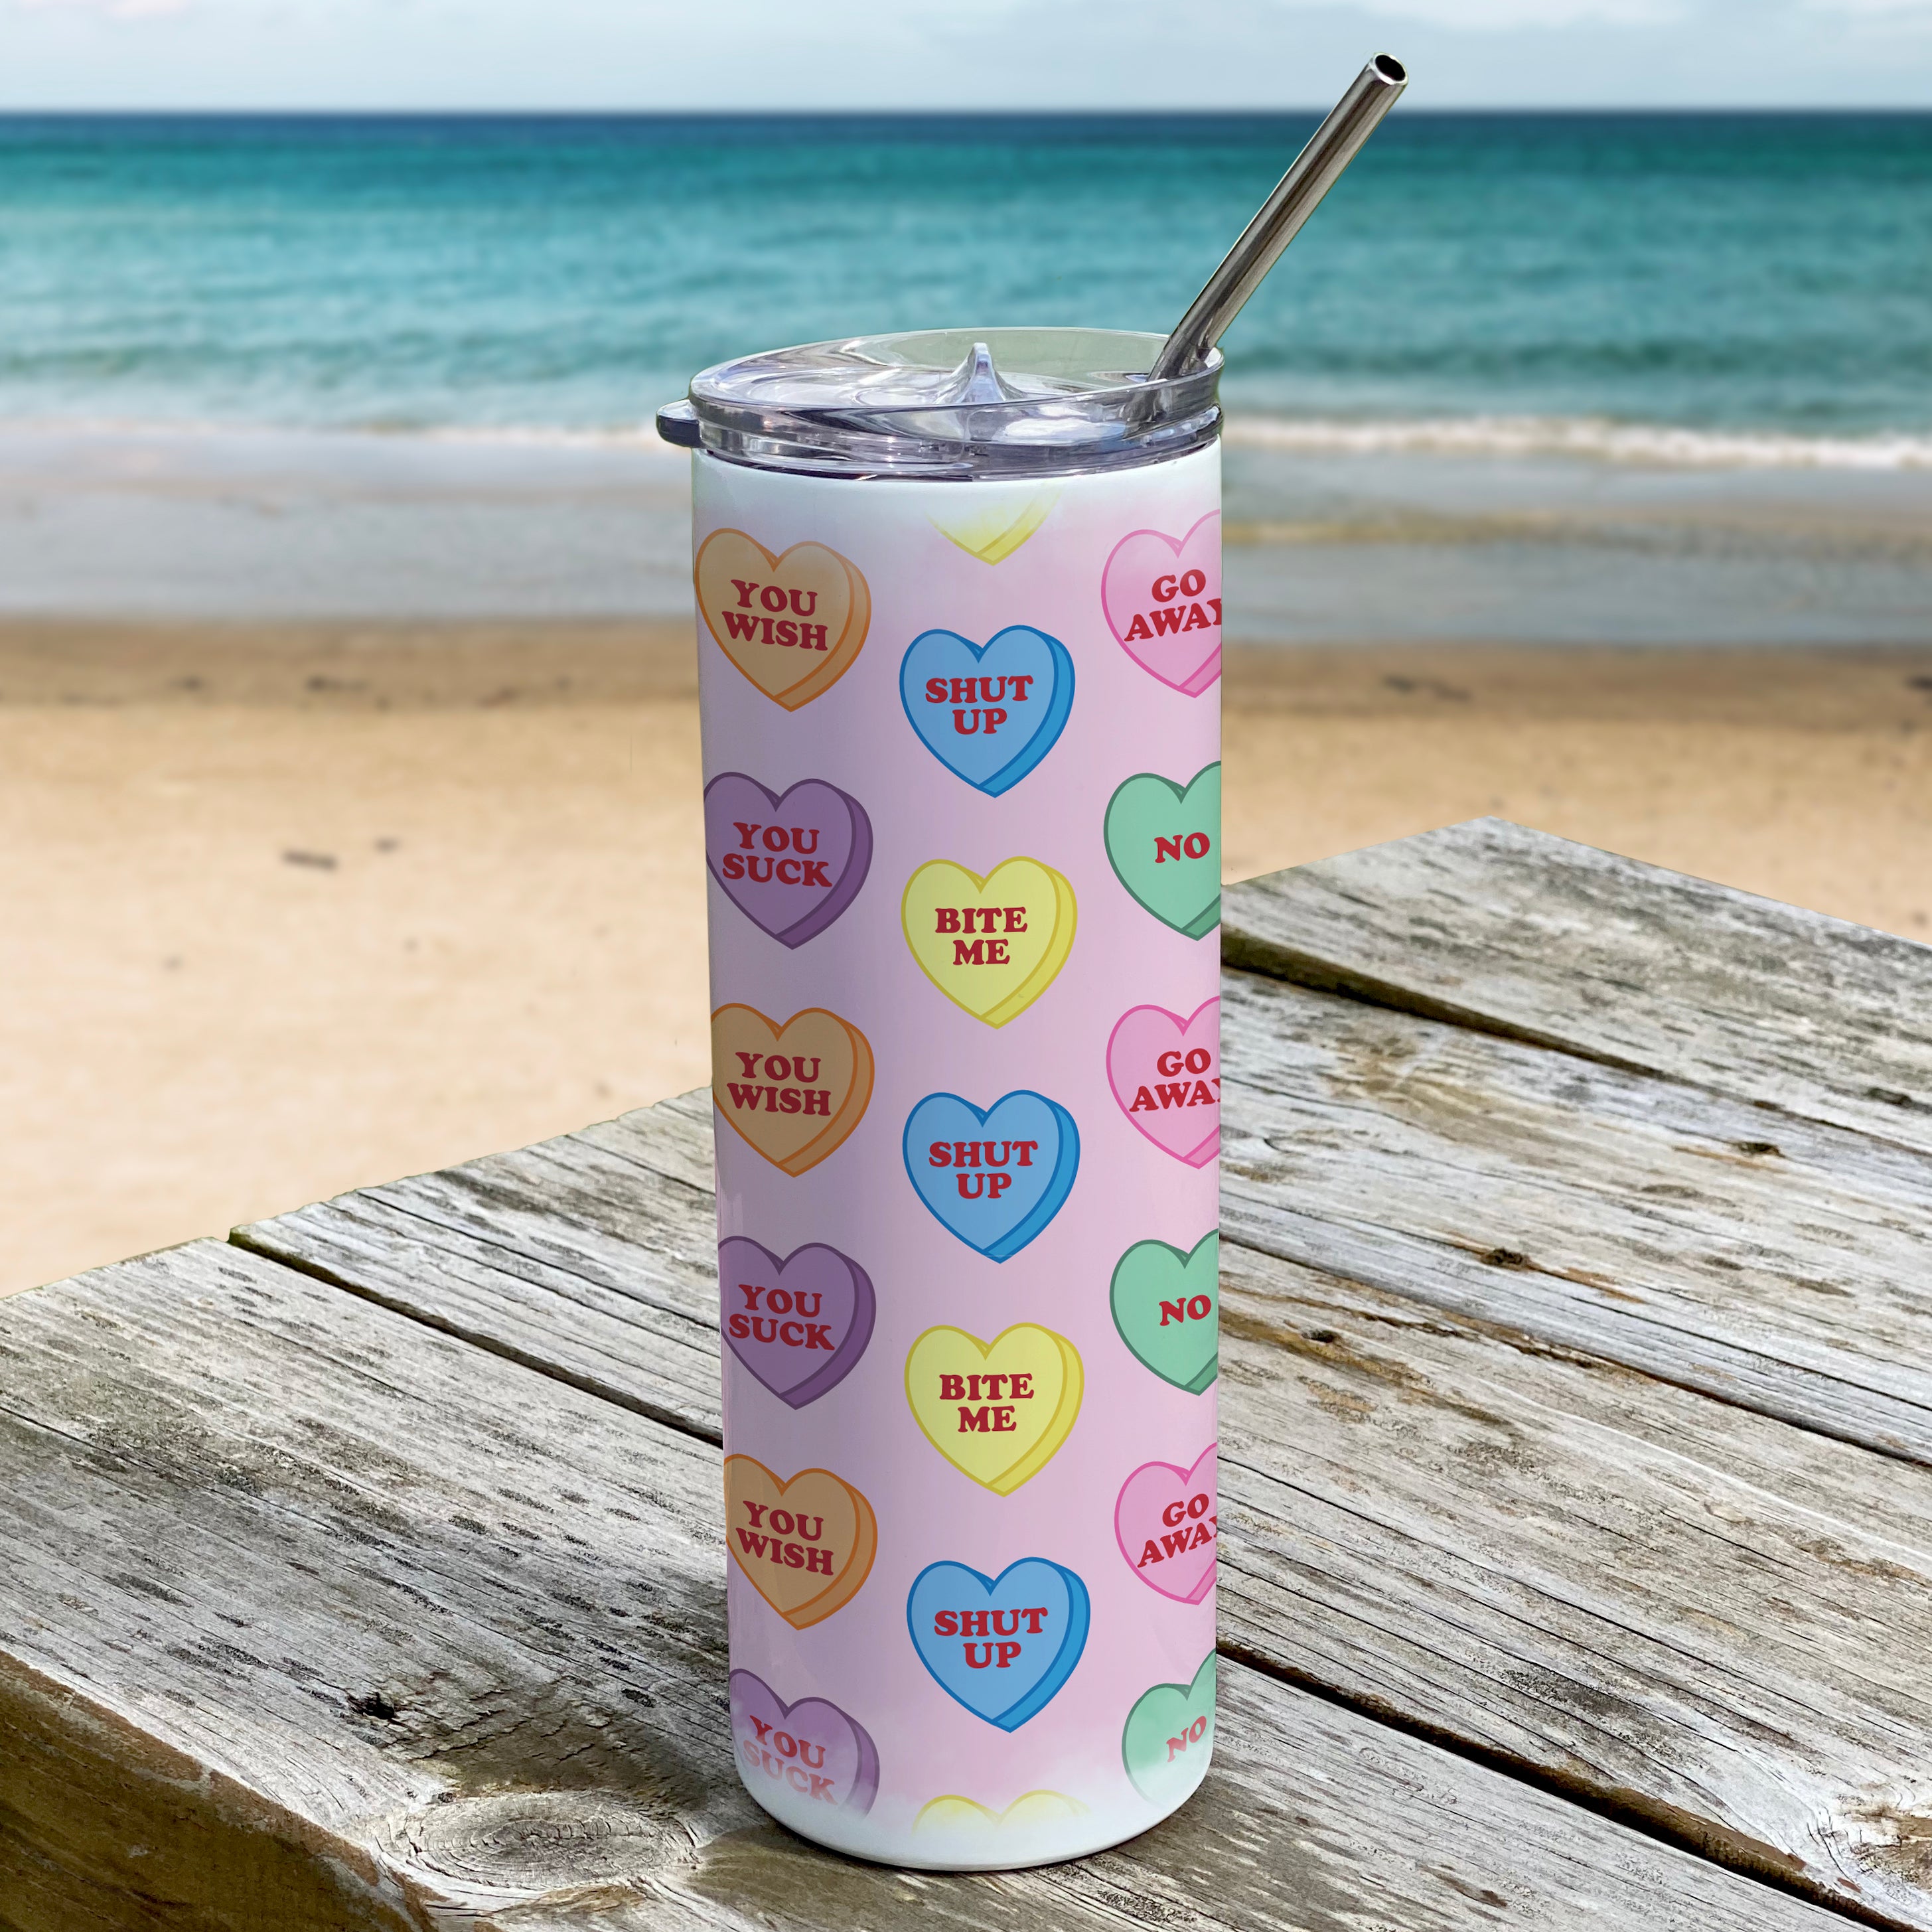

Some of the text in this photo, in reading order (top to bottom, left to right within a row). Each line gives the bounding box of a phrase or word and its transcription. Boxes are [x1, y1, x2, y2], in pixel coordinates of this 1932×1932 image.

[730, 579, 818, 617] YOU
[1152, 569, 1207, 603] GO
[722, 611, 828, 651] WISH
[925, 675, 1033, 704] SHUT
[952, 707, 1007, 735] UP
[733, 822, 819, 854] YOU
[1154, 832, 1210, 863] NO
[723, 854, 832, 887] SUCK
[935, 907, 1027, 934] BITE
[953, 938, 1010, 965] ME
[735, 1052, 821, 1082] YOU
[1156, 1047, 1211, 1077] GO
[727, 1082, 831, 1116] WISH
[929, 1141, 1038, 1167] SHUT
[956, 1173, 1012, 1199] UP
[738, 1284, 822, 1317] YOU
[1159, 1294, 1211, 1327] NO
[729, 1313, 835, 1351] SUCK
[939, 1373, 1034, 1401] BITE
[958, 1405, 1017, 1432] ME
[742, 1499, 824, 1540] YOU
[1162, 1493, 1209, 1527] GO
[735, 1528, 834, 1576] WISH
[934, 1607, 1048, 1637] SHUT
[963, 1641, 1022, 1669] UP
[749, 1714, 826, 1769] YOU
[1165, 1716, 1207, 1763] NO
[743, 1739, 839, 1806] SUCK
